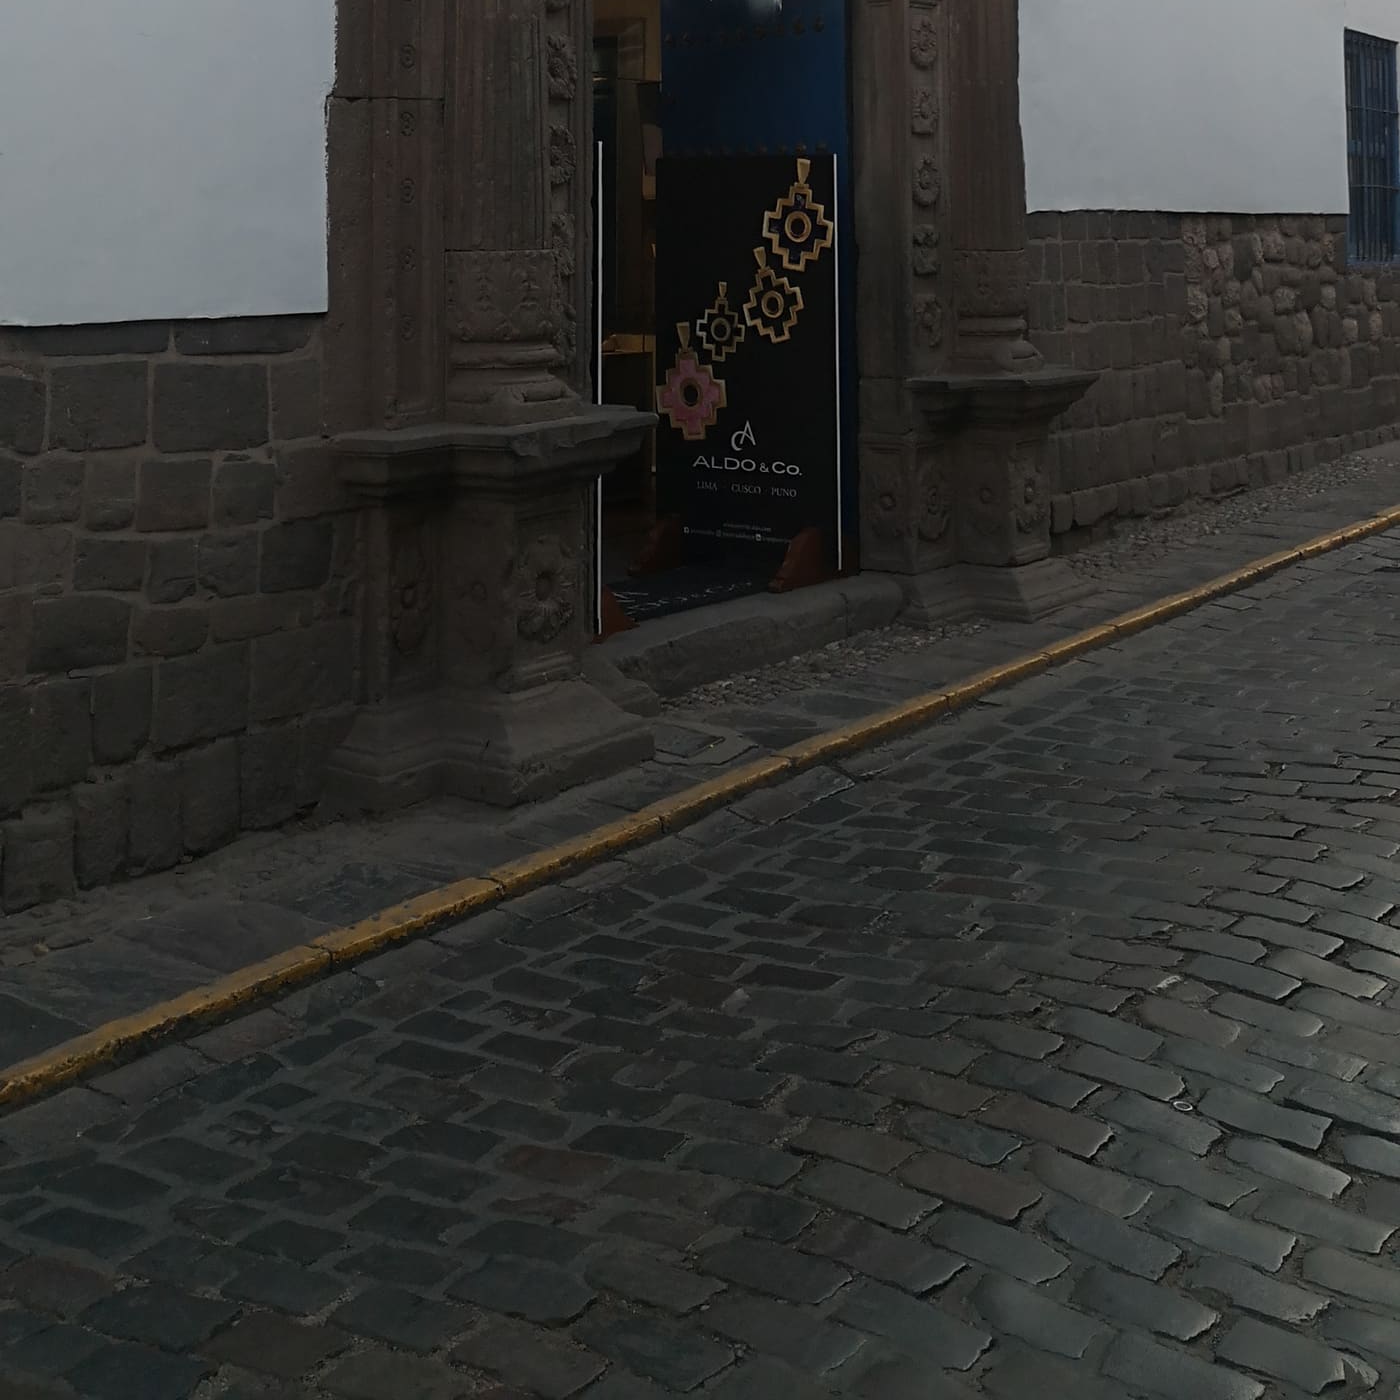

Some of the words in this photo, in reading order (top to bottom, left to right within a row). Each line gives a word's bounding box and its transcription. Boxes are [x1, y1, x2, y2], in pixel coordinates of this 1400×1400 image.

[692, 455, 757, 472] ALDO
[759, 462, 770, 474] &
[696, 480, 718, 491] LIMA
[731, 482, 762, 495] CUSCO
[770, 487, 798, 498] PUNO
